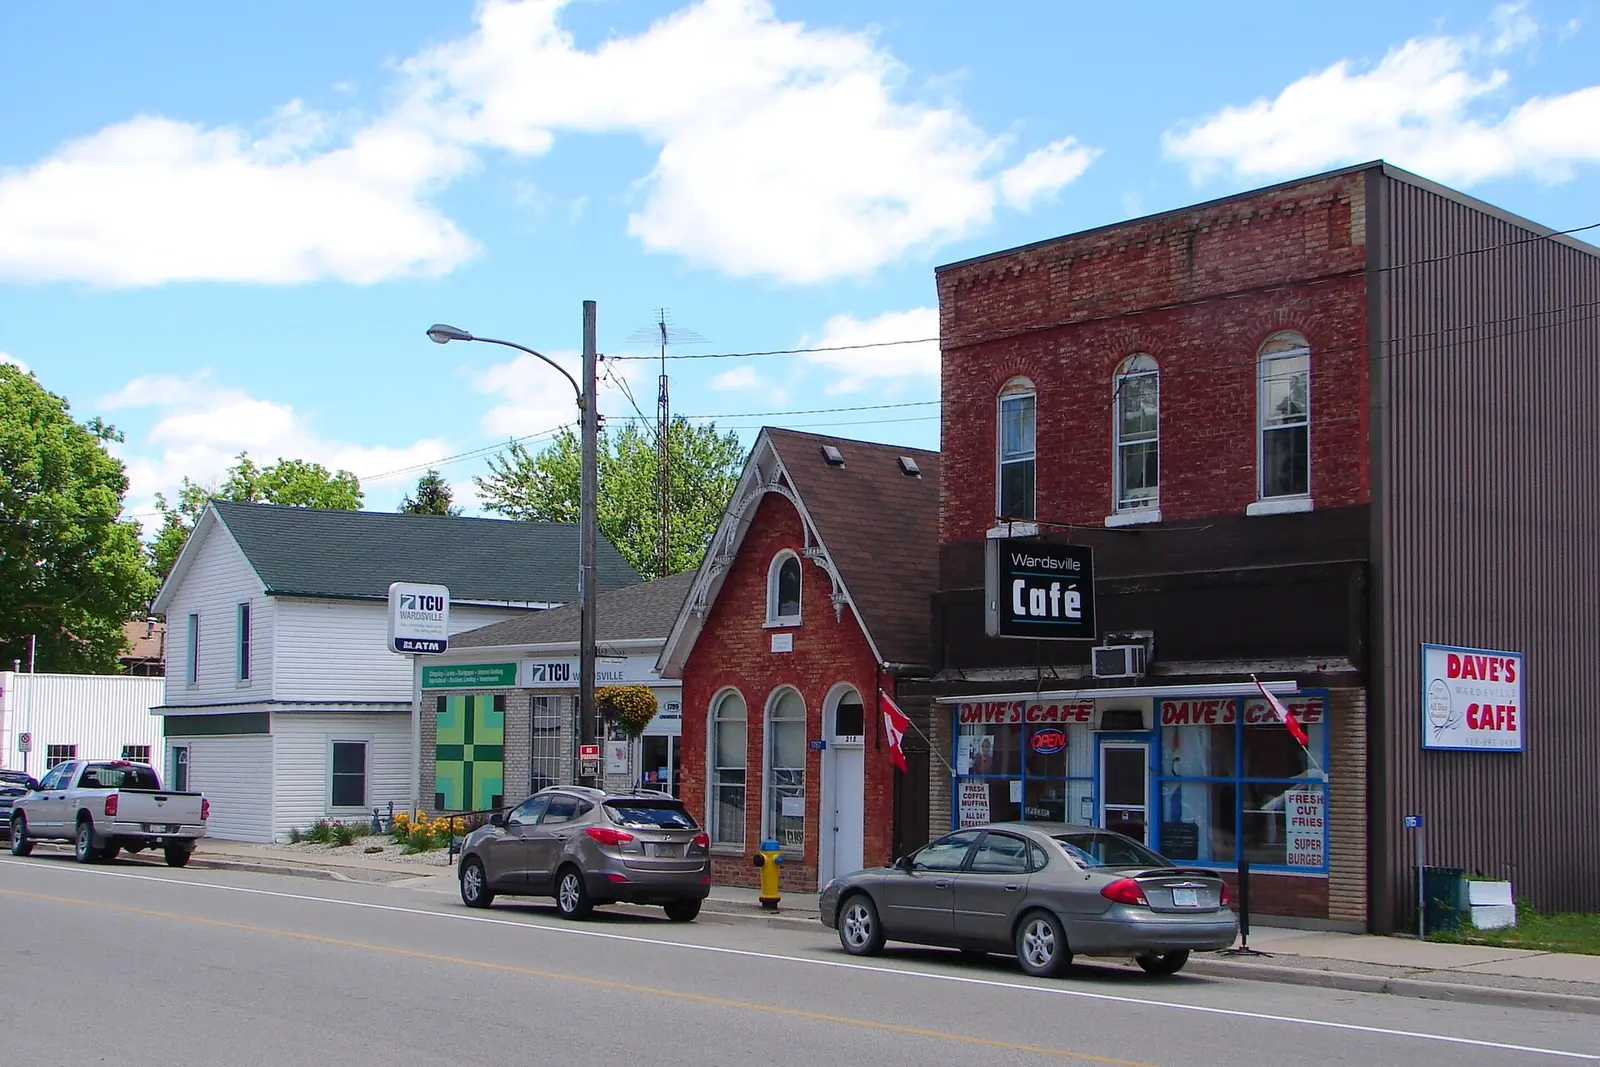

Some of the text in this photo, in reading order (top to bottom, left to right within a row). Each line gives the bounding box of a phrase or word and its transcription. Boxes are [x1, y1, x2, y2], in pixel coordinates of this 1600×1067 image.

[1011, 552, 1081, 571] Wardsville
[418, 595, 444, 612] TCU
[1012, 579, 1082, 618] Café
[400, 610, 443, 622] WARDSVILLE
[415, 642, 439, 651] ATM
[548, 663, 570, 682] TCU
[1447, 653, 1516, 683] DAVE'S
[960, 702, 1022, 724] DAVE'S
[1162, 701, 1237, 725] DAVE'S
[1466, 700, 1517, 731] CAFÉ
[1031, 733, 1067, 749] OPEN
[965, 785, 985, 793] FRESH
[1288, 794, 1324, 805] FRESH
[965, 812, 986, 820] ALL DAY
[1296, 806, 1318, 816] CUT
[1291, 817, 1323, 828] FRIES
[1294, 838, 1322, 851] SUPER
[1288, 852, 1322, 866] BURGER
